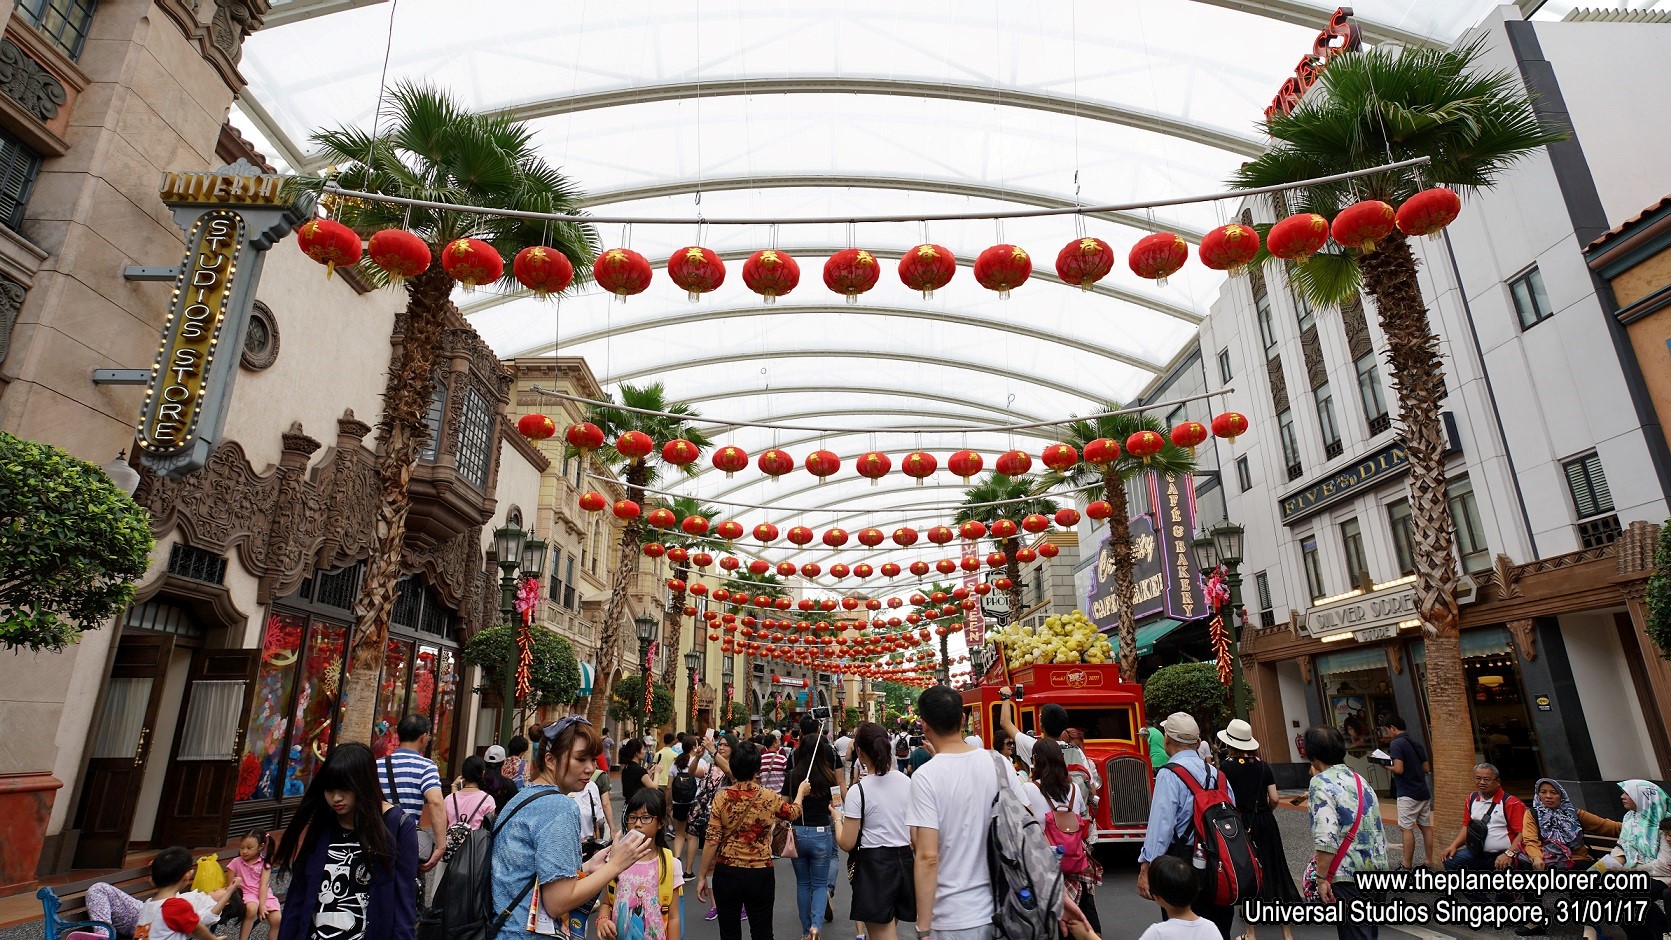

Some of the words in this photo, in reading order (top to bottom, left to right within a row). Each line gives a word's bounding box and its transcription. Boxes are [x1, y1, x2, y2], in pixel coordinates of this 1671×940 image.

[1263, 7, 1359, 120] RESS
[181, 219, 232, 339] STUDIOS
[153, 348, 199, 440] STORE
[1284, 478, 1338, 515] FIVE
[1357, 447, 1411, 481] DIM
[1172, 526, 1184, 538] &
[986, 597, 1011, 606] PHOT
[1175, 540, 1194, 617] BAKERY
[966, 582, 980, 642] SCEEN
[1315, 605, 1367, 630] SILVER
[1369, 592, 1418, 618] SCRE
[1361, 626, 1392, 640] STORE
